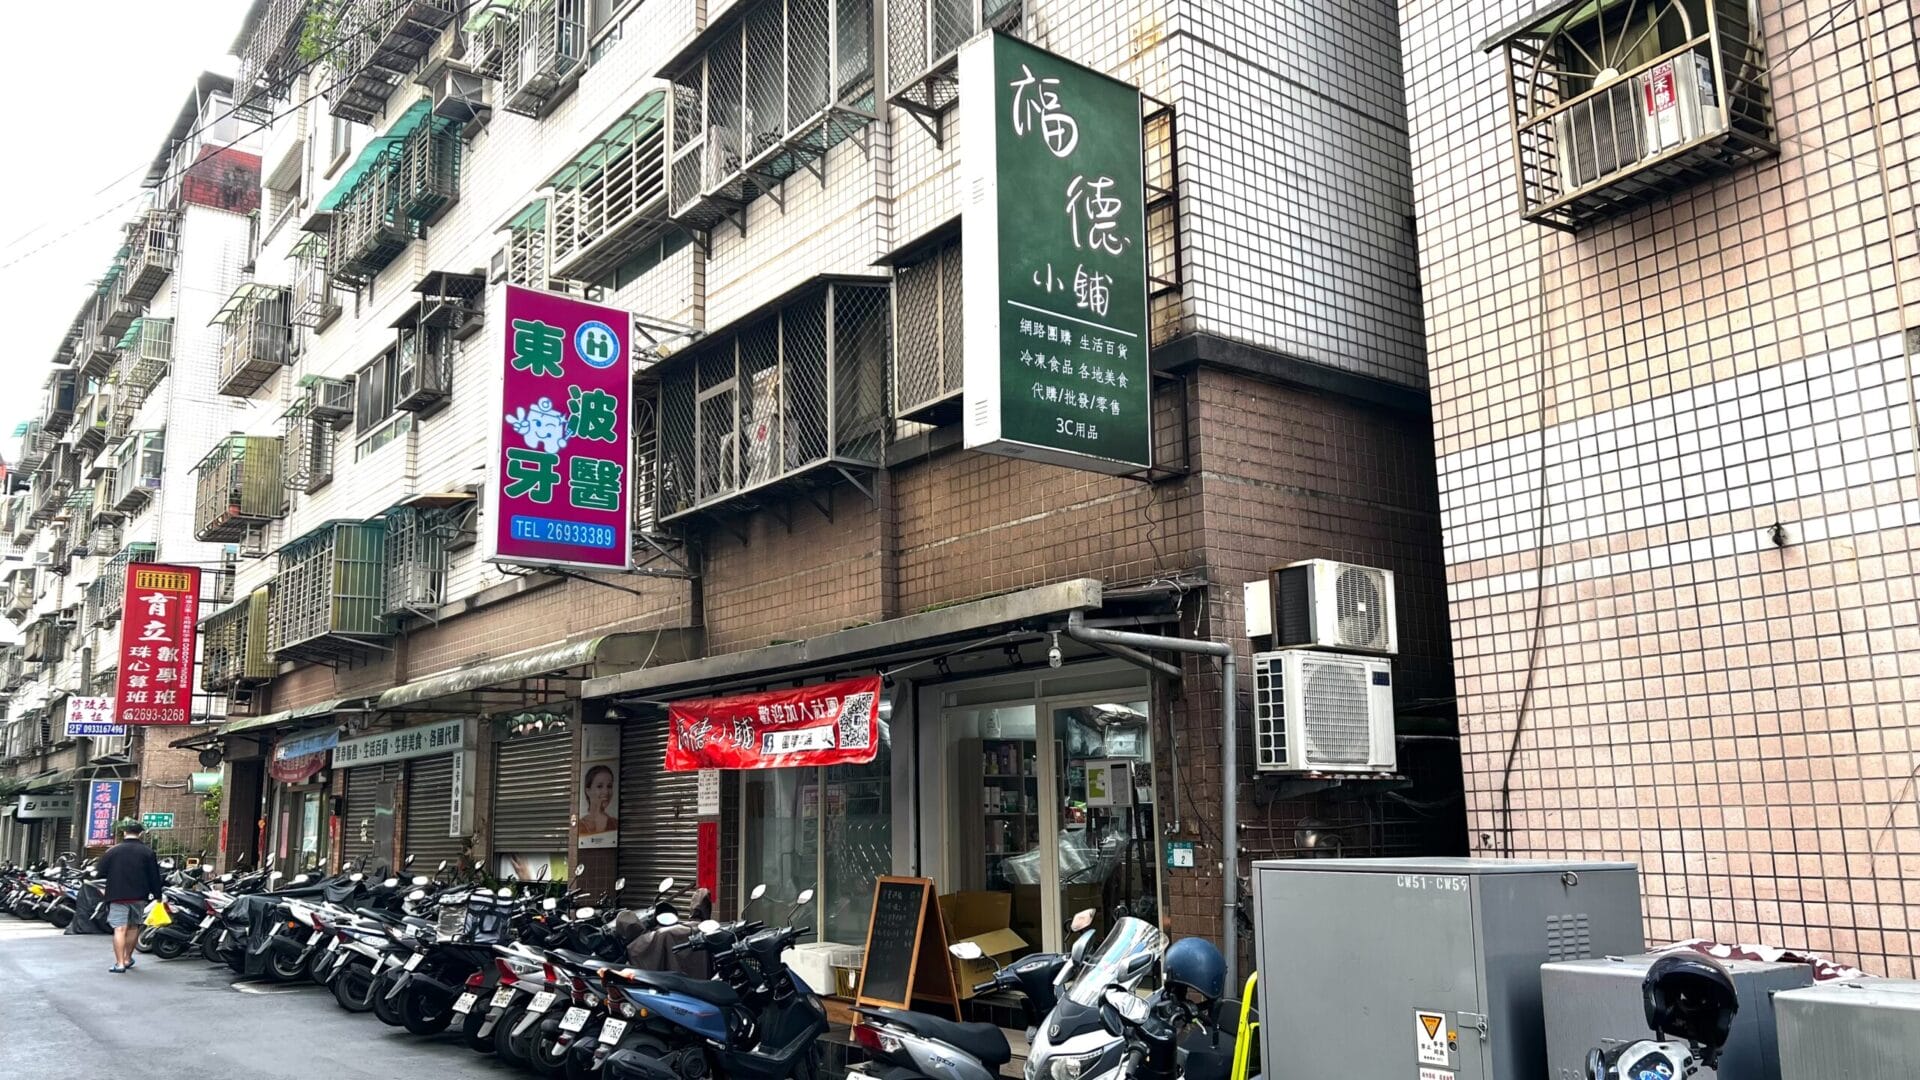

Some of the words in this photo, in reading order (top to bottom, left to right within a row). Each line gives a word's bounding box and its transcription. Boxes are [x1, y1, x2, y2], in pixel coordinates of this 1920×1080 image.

[1010, 63, 1079, 159] 福
[1065, 174, 1131, 256] 德
[511, 318, 565, 377] 東
[1020, 317, 1072, 347] 網路團購
[1079, 333, 1129, 361] 生活百貨
[1020, 351, 1073, 376] 冷凍食品
[1078, 362, 1129, 388] 各地美食
[566, 384, 617, 443] 波
[1031, 382, 1121, 417] 代購/批發/零售
[1055, 417, 1098, 440] 3C用品
[504, 447, 622, 512] 牙醫
[516, 519, 539, 540] TEL
[547, 522, 611, 547] 26933389
[138, 592, 177, 642] 育立
[126, 645, 152, 703] 珠心算班
[154, 646, 179, 705] 數學班
[71, 699, 115, 710] 修改衣
[133, 708, 185, 721] 2693-3268
[758, 697, 840, 725] 歡迎加入社團
[69, 724, 82, 734] 2F
[83, 724, 124, 734] 0933167496
[1181, 855, 1187, 865] 2
